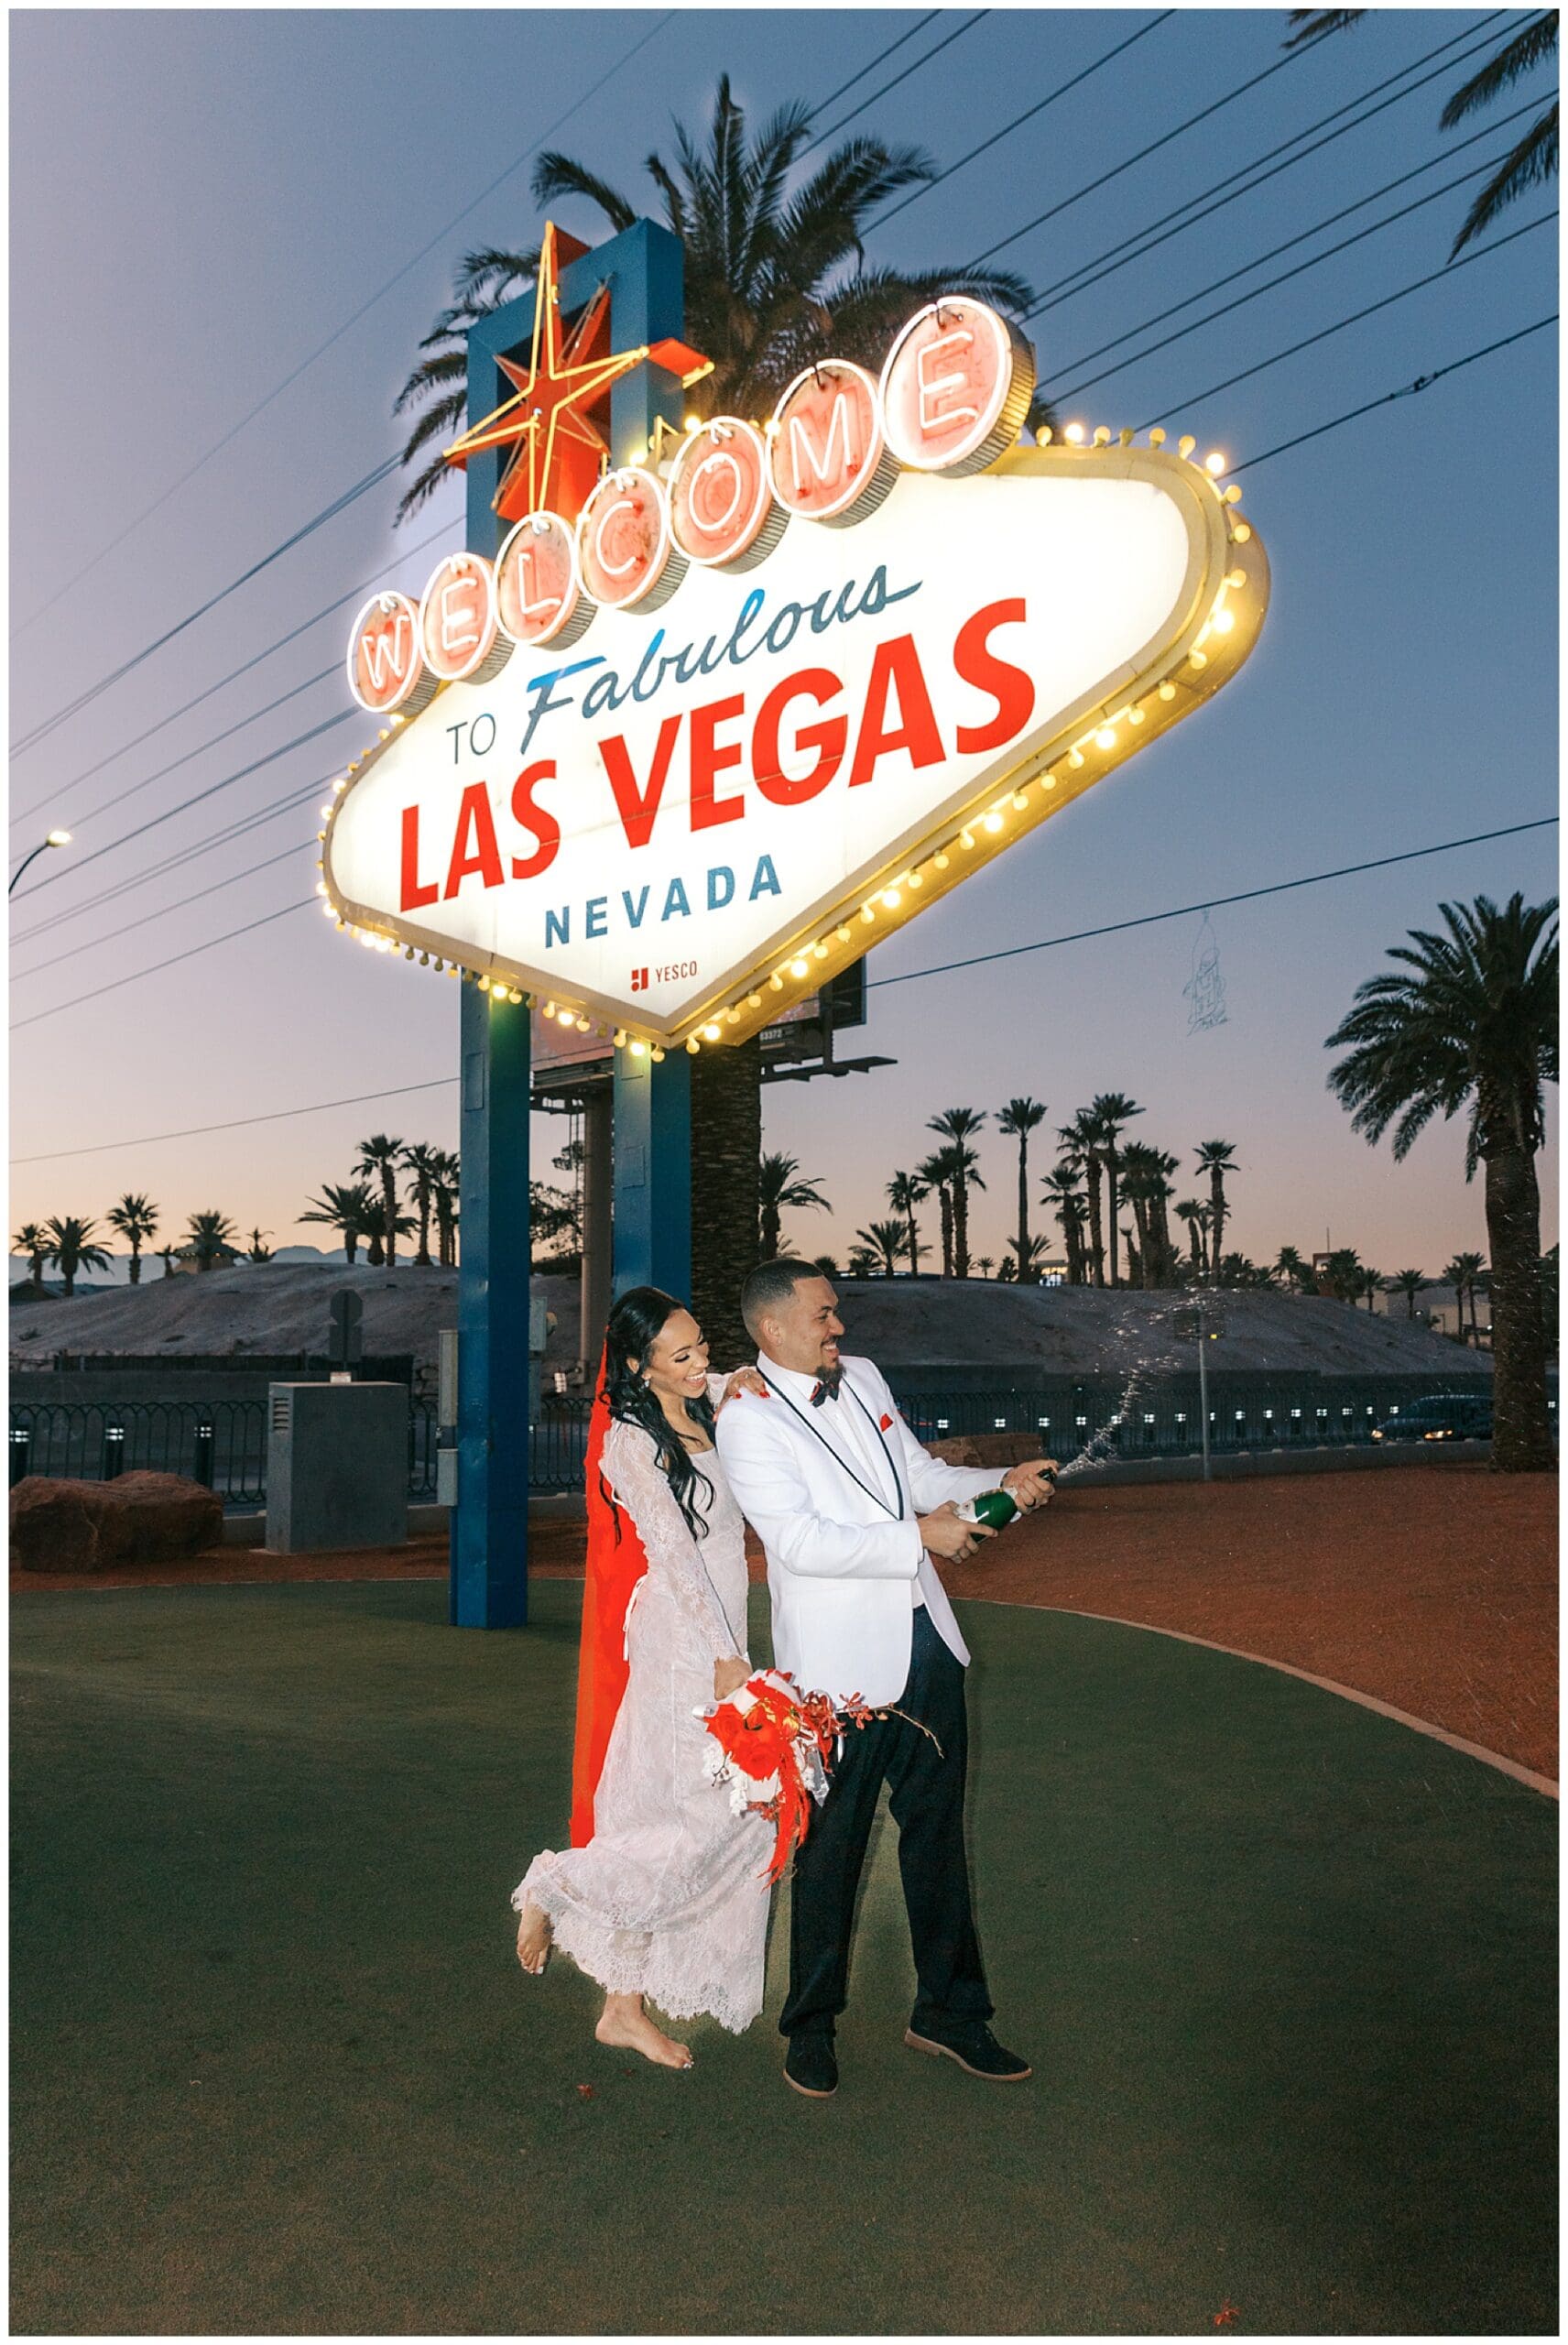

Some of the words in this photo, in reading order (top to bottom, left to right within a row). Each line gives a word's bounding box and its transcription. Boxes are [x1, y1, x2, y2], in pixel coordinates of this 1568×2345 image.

[361, 331, 978, 693] WELCOME
[399, 759, 561, 912] LAS
[598, 597, 1036, 848] VEGAS
[446, 713, 497, 765] TO
[519, 563, 923, 755] Fabulous
[545, 854, 782, 948] NEVADA
[655, 960, 698, 983] YESCO
